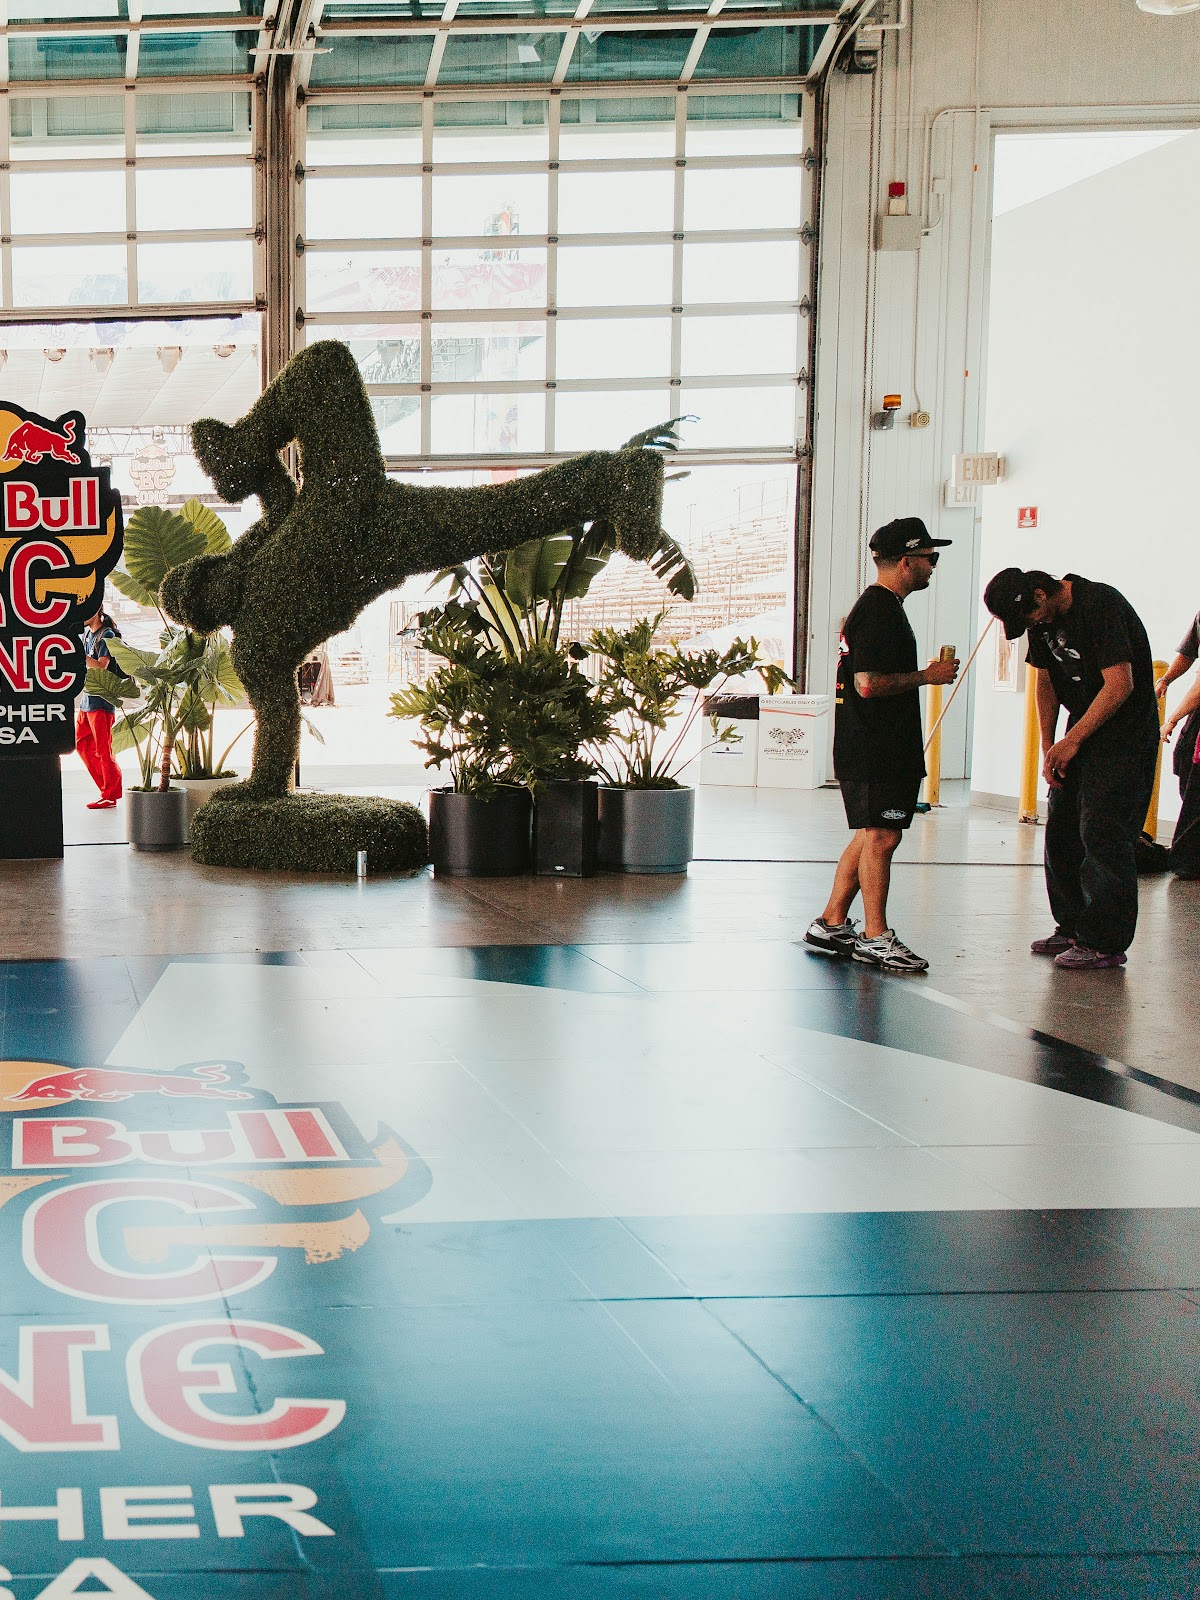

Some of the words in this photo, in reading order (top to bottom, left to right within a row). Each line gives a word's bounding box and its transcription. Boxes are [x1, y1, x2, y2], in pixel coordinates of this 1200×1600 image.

[131, 459, 153, 471] Red
[962, 458, 993, 480] EXIT
[138, 470, 169, 490] BC
[4, 477, 100, 531] Bull
[11, 1106, 354, 1170] Bull
